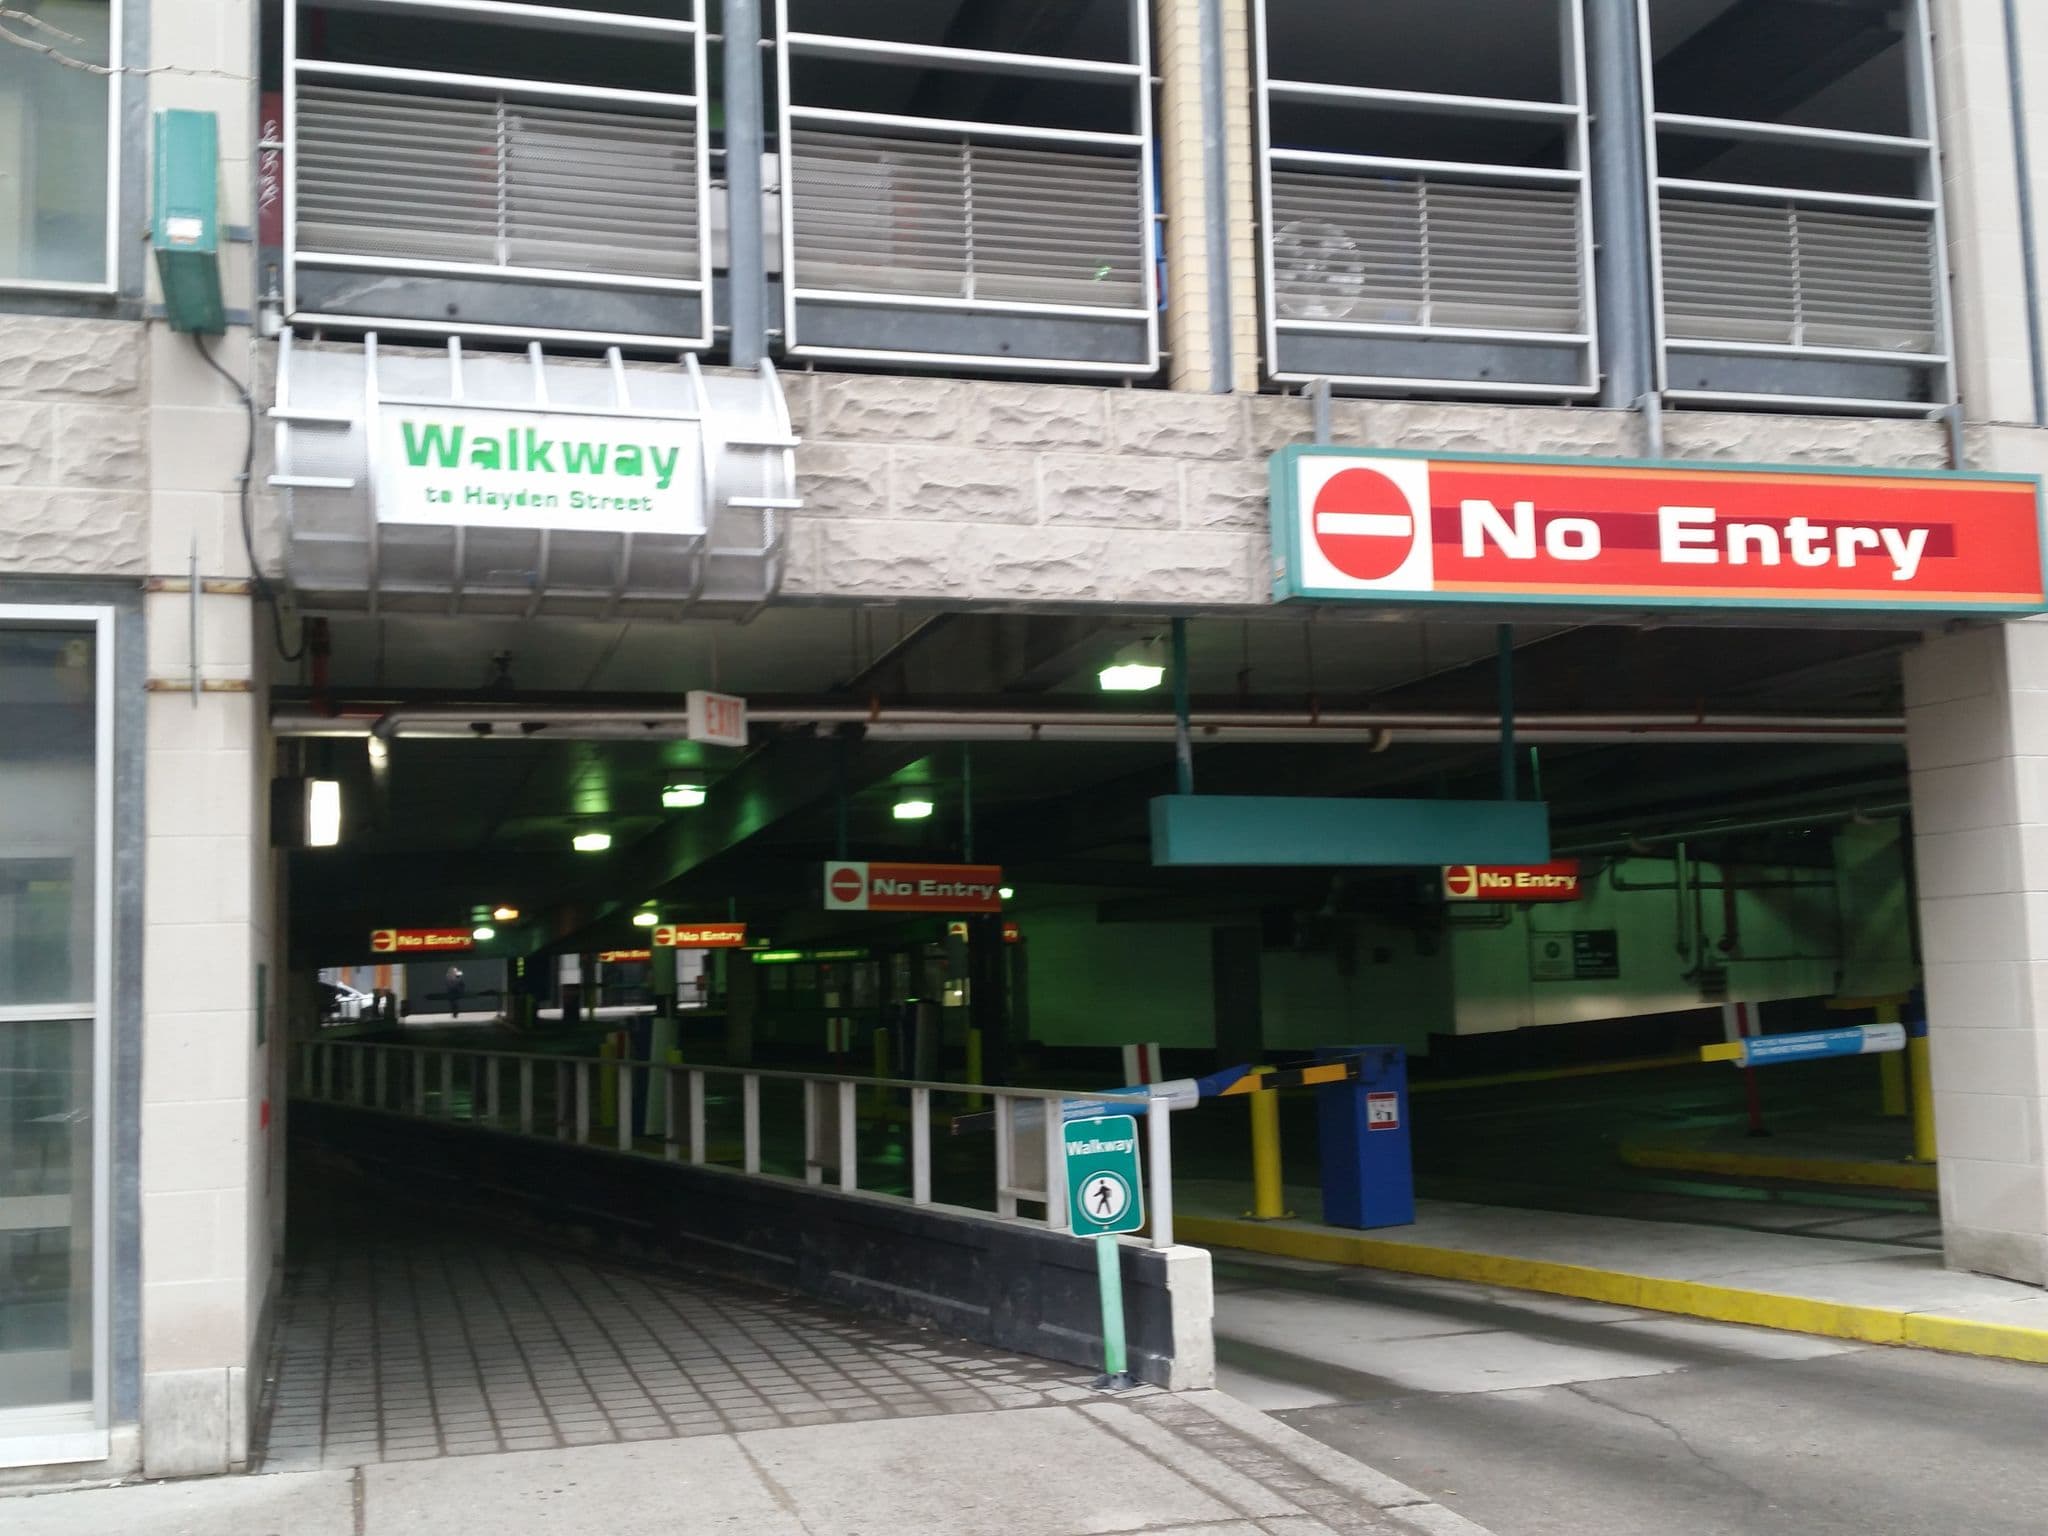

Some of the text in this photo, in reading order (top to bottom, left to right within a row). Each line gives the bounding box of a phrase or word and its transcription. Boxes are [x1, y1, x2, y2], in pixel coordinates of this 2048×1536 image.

[402, 421, 680, 490] Walkway
[425, 485, 654, 511] to Hayden Street
[1459, 498, 1930, 581] No Entry
[704, 695, 742, 738] EXIT
[873, 878, 995, 900] No Entry
[1478, 872, 1578, 890] No Entry
[397, 934, 472, 946] No Entry
[676, 931, 743, 942] No Entry
[1066, 1139, 1134, 1156] Walkway
